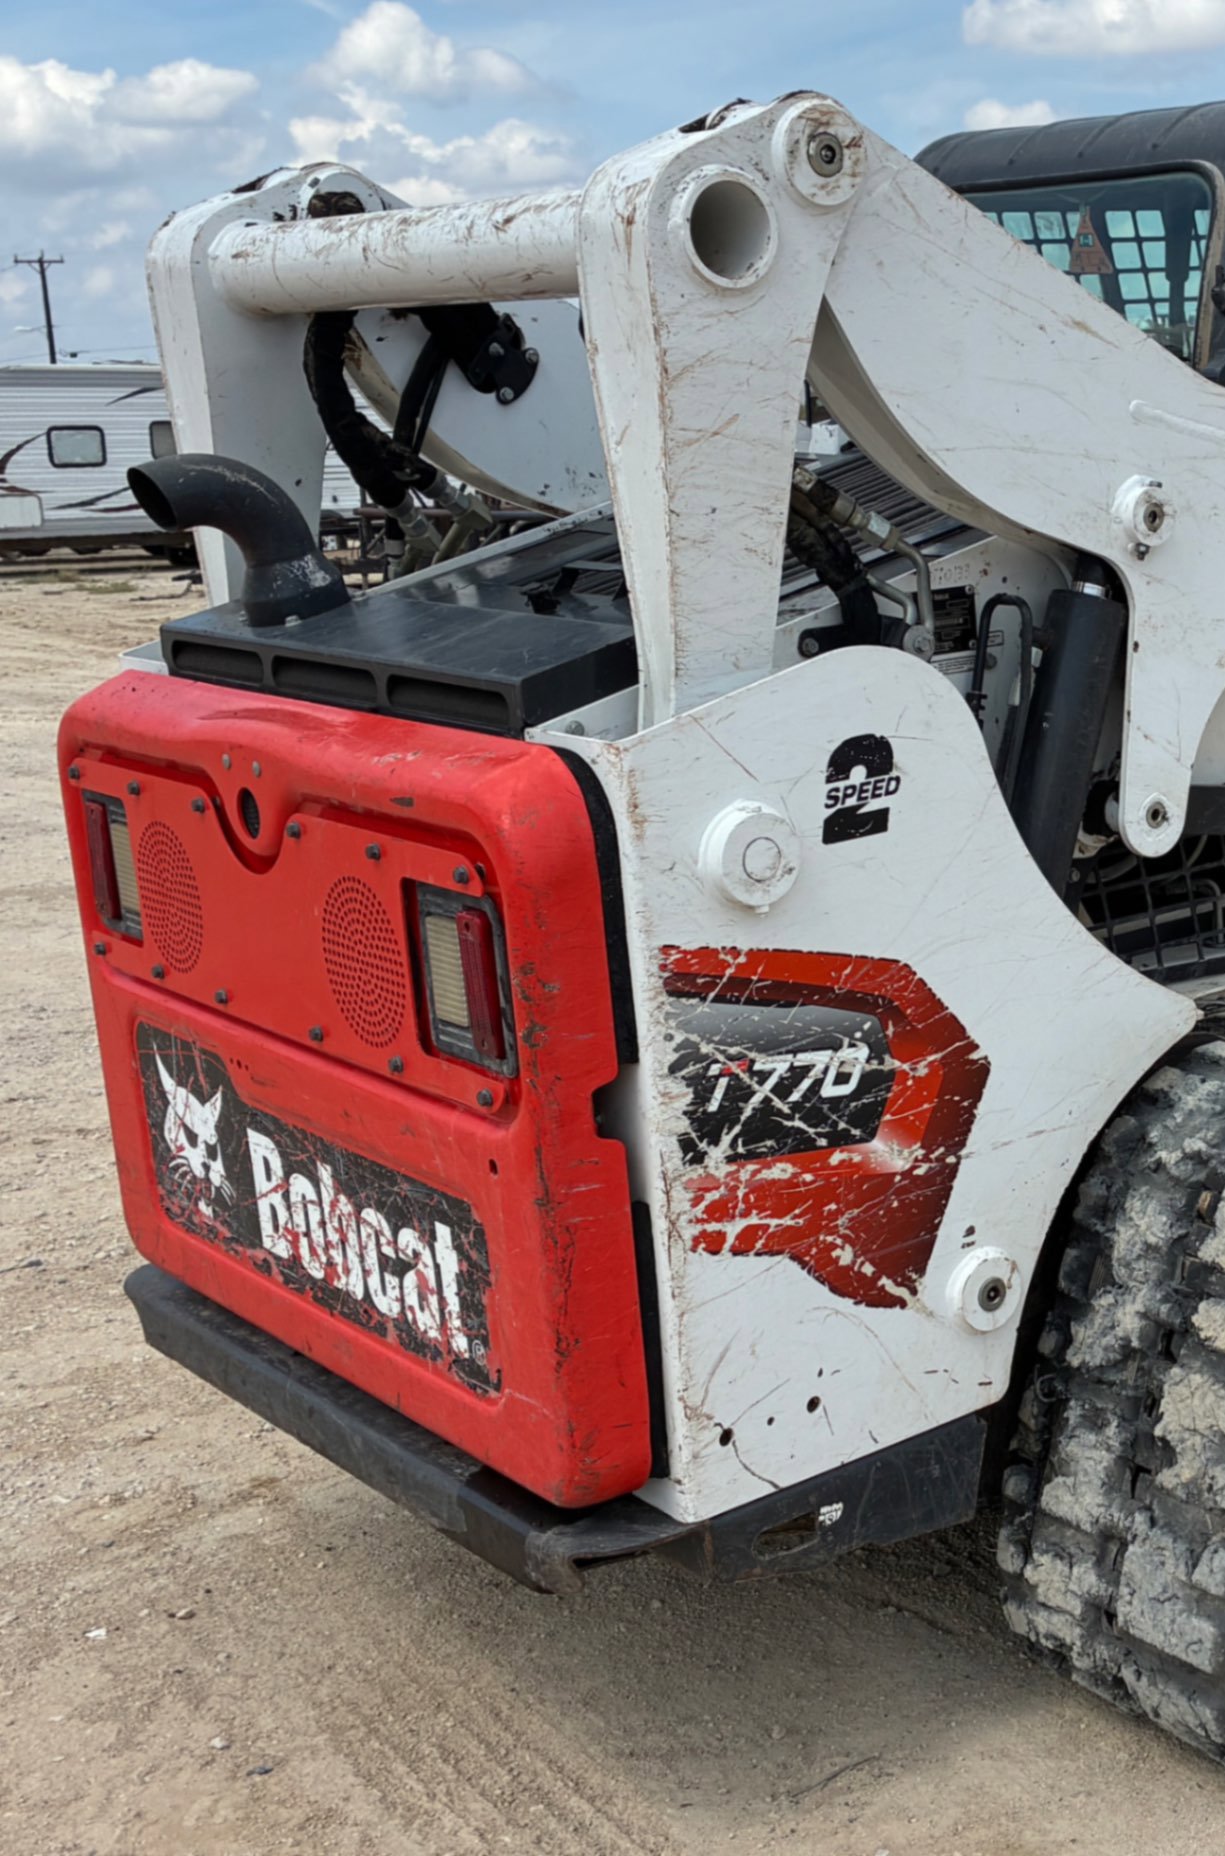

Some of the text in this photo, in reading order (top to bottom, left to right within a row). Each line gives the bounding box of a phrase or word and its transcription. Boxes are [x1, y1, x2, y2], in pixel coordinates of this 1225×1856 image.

[824, 775, 901, 810] SPEED
[706, 1046, 870, 1114] T770
[246, 1127, 470, 1359] Bobcat
